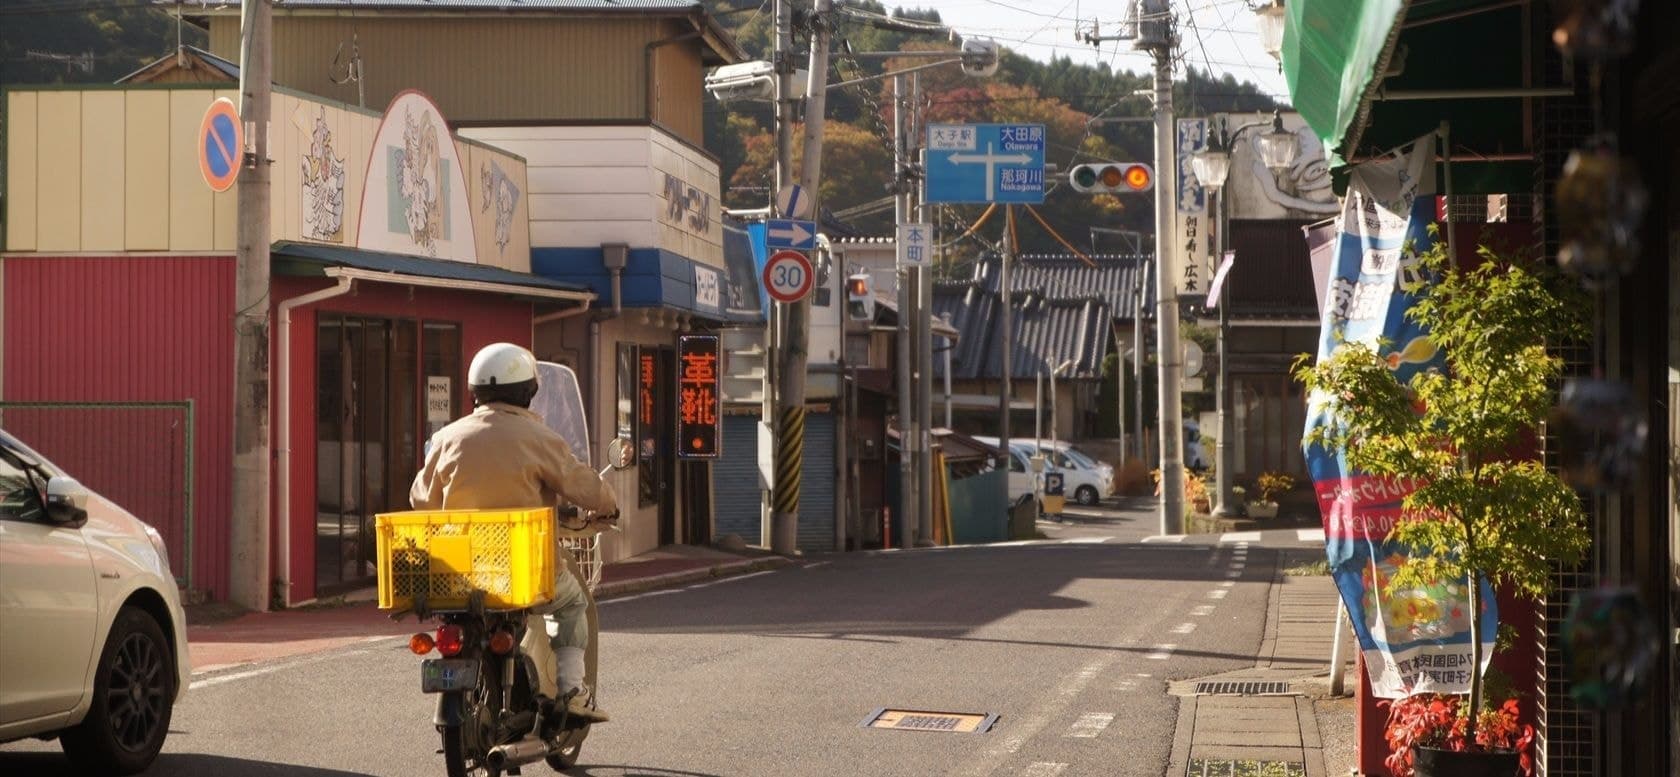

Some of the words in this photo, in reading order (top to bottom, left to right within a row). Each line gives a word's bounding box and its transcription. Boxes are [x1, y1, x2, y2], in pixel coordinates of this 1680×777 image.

[934, 128, 971, 140] 大子駅
[1001, 127, 1042, 142] 大田原
[1001, 168, 1042, 183] 那珂川
[1000, 183, 1042, 192] Nakagawa
[906, 227, 924, 262] 本町
[774, 265, 803, 288] 30
[682, 351, 717, 425] 革靴
[1049, 475, 1061, 493] P
